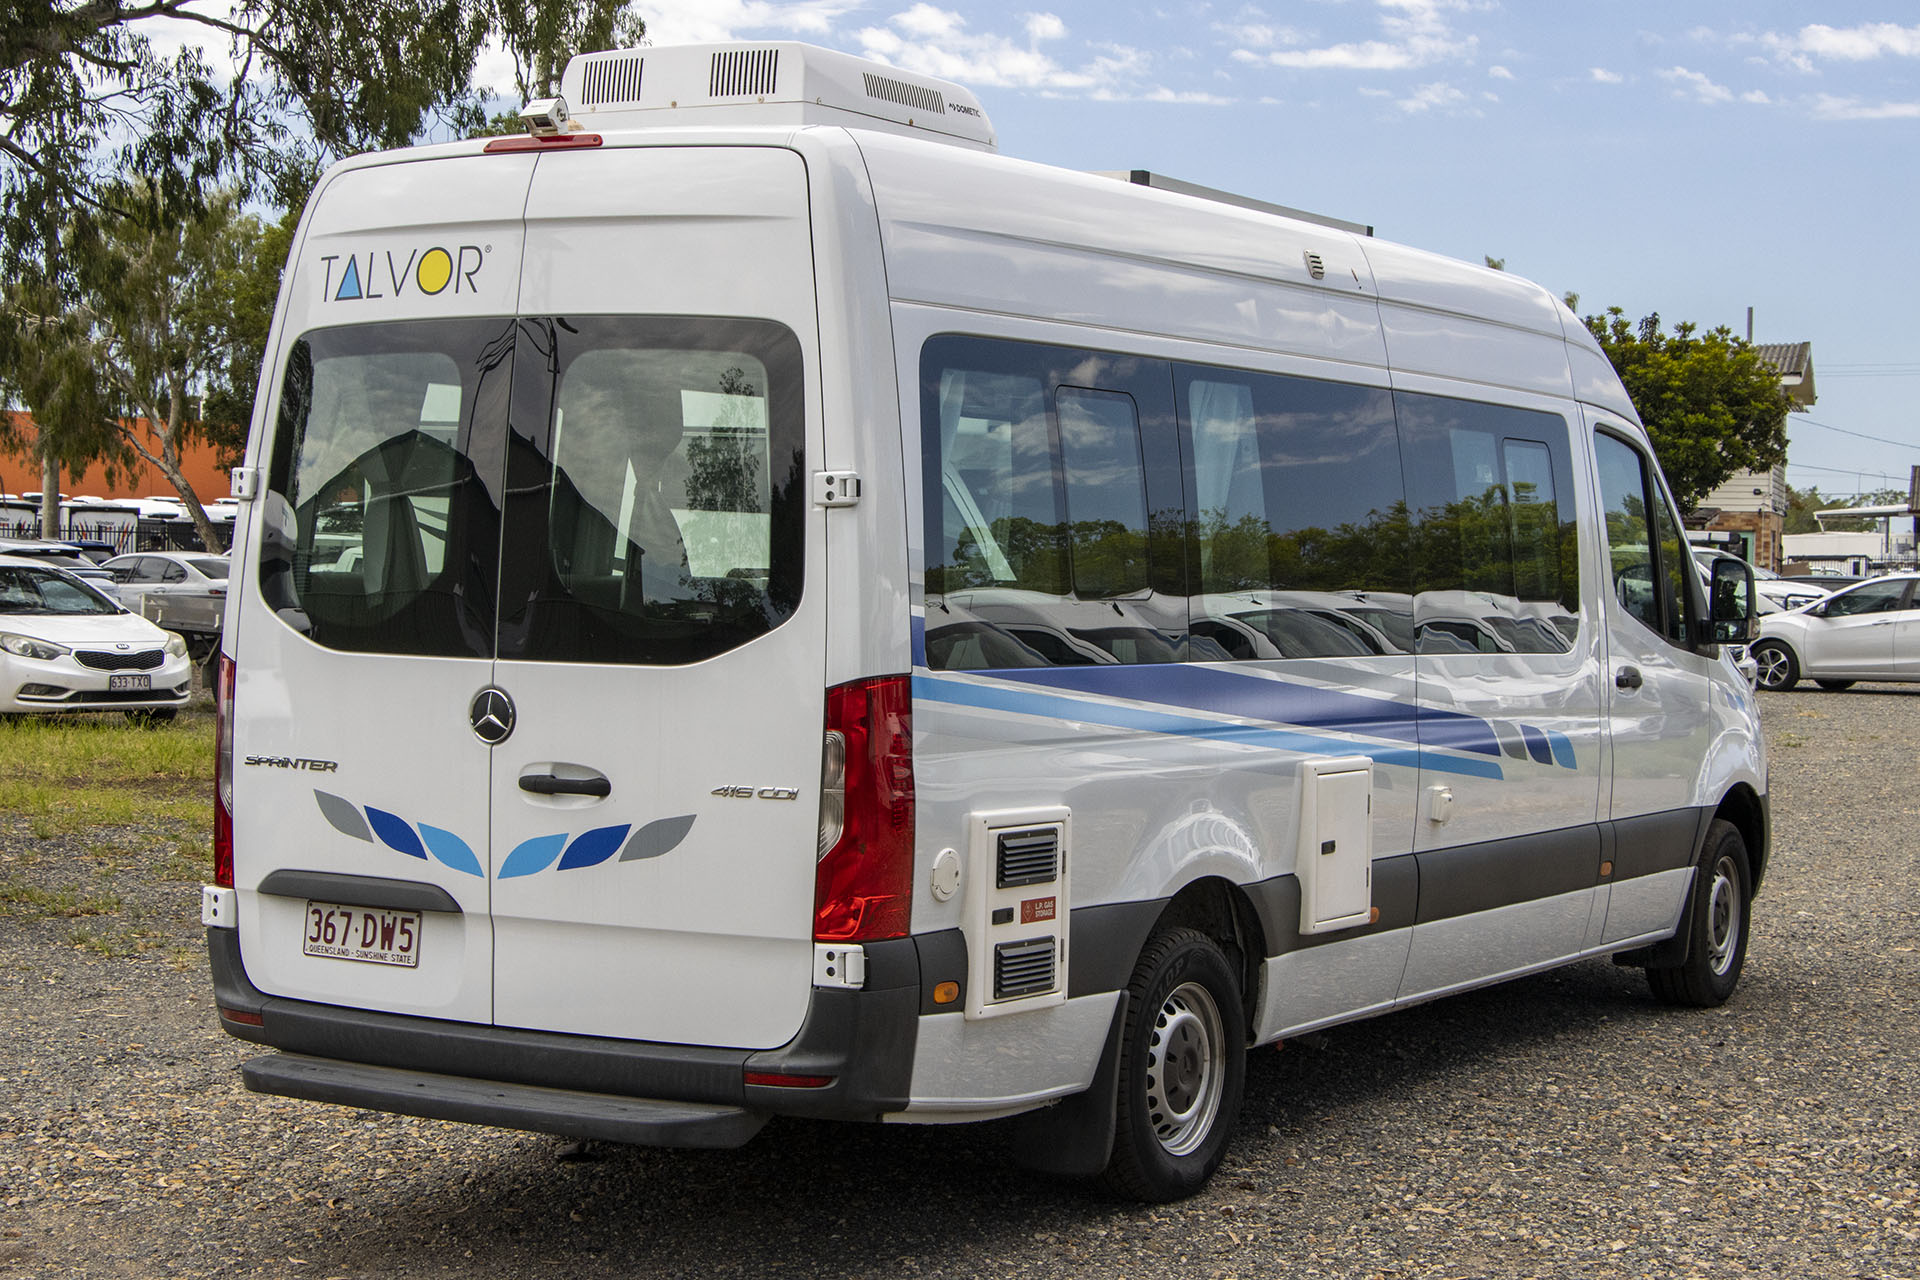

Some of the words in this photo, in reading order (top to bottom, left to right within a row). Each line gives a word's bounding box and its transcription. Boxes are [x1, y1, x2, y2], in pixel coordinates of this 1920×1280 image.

[244, 756, 338, 773] SPRINTER
[711, 784, 755, 799] 416
[757, 786, 800, 800] CDI
[1044, 900, 1054, 909] GAS
[1035, 908, 1054, 918] STORAGE
[308, 944, 350, 957] QUEENSLAND
[355, 949, 389, 962] SUNSHINE
[391, 953, 412, 964] STATE
